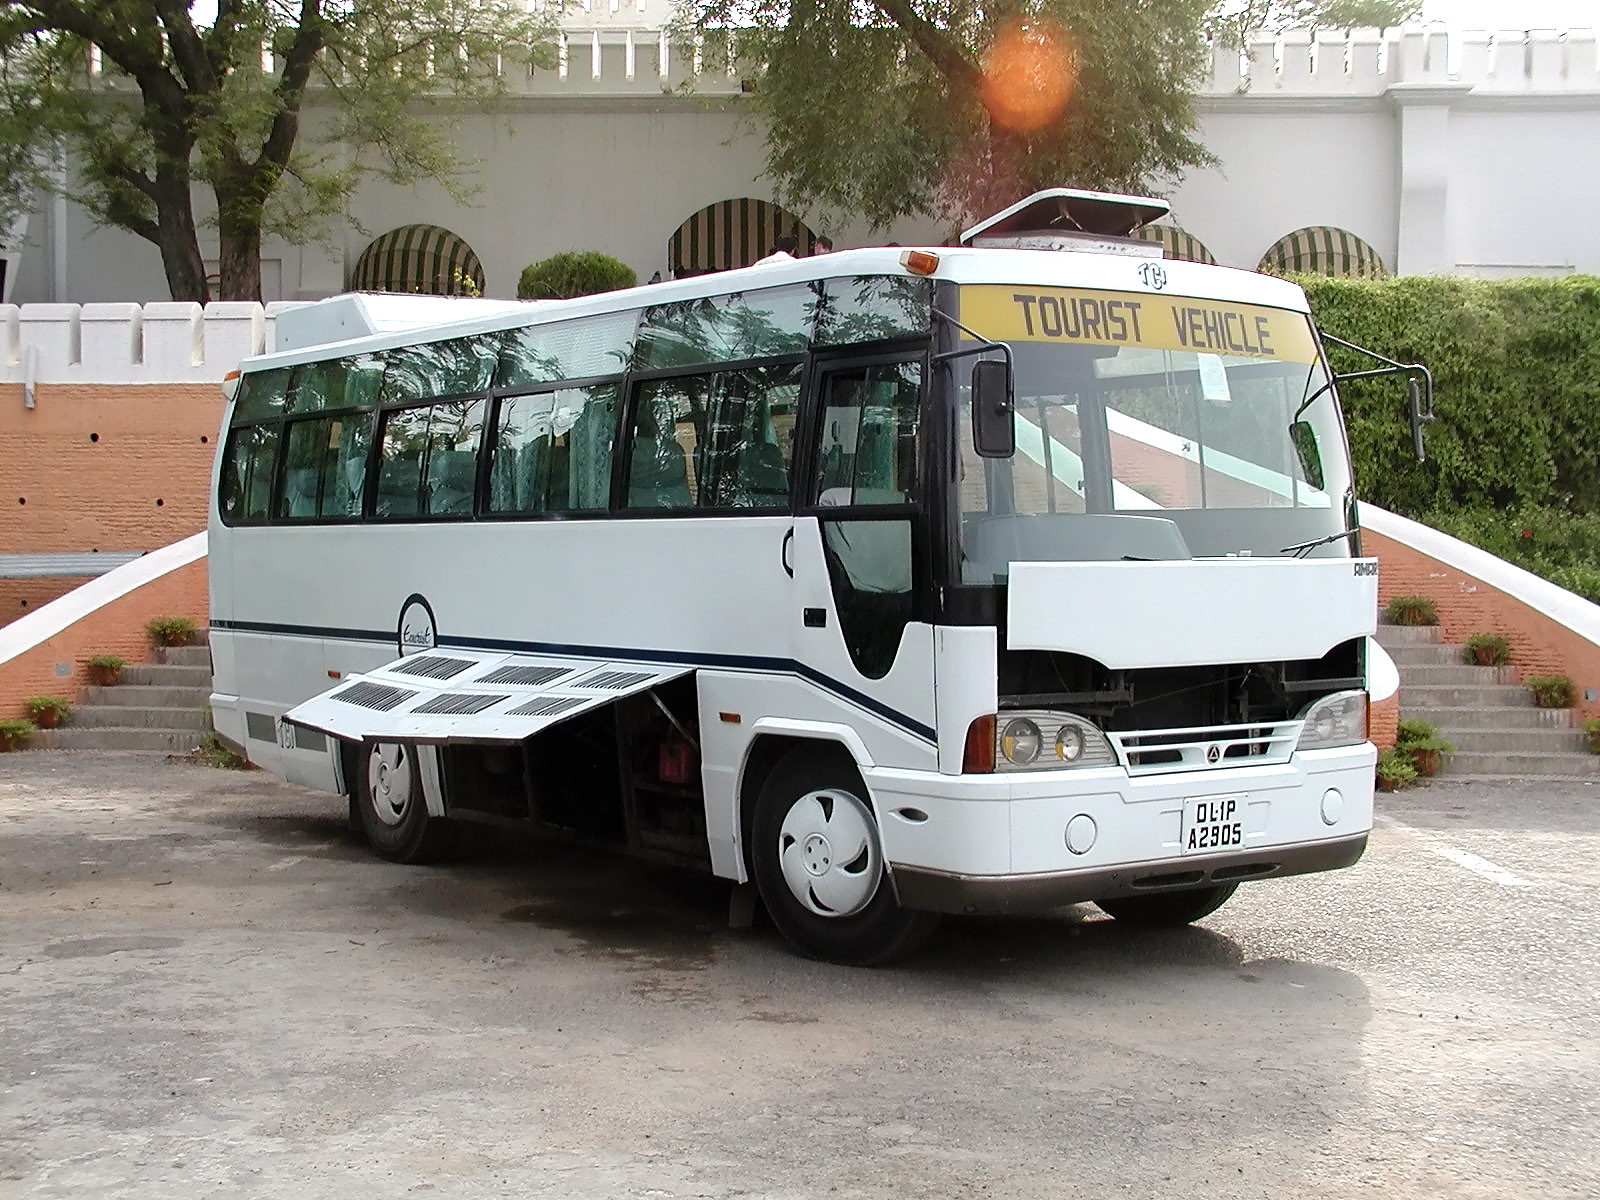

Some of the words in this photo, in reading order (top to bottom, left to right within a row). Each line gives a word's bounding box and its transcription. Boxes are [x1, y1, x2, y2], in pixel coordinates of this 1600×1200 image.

[1012, 294, 1142, 343] TOURIST
[1171, 306, 1275, 354] VEHICLE
[1188, 823, 1241, 849] A2905
